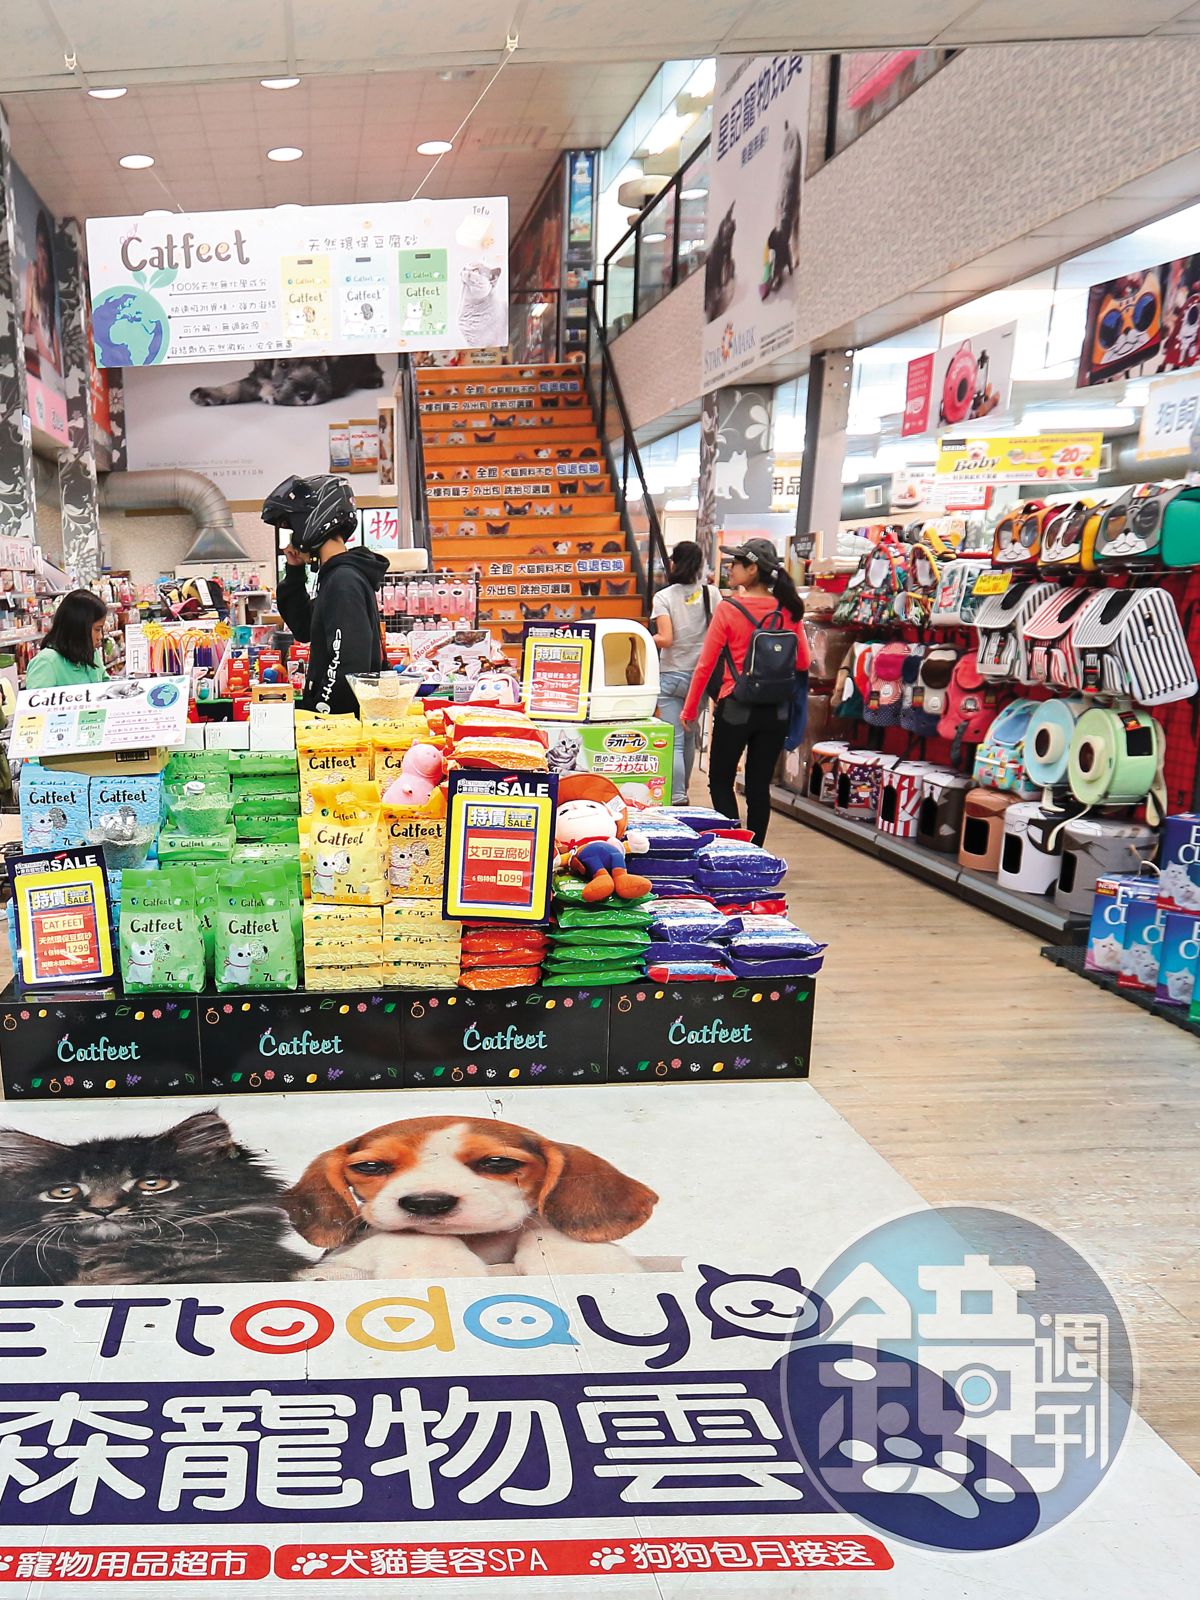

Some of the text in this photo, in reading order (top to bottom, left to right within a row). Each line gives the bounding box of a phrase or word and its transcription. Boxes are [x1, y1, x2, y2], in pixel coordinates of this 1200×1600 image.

[120, 229, 251, 272] Catfeet
[490, 564, 513, 575] 全館
[576, 559, 625, 573] 包退包換
[486, 586, 517, 597] 外出包
[555, 629, 590, 639] SALE
[28, 689, 92, 708] Catfeet
[607, 738, 646, 748] デオトイレ
[308, 755, 357, 770] Catfeet
[99, 789, 148, 804] Catfeet
[496, 781, 550, 797] SALE
[29, 790, 78, 805] Catfeet
[470, 807, 506, 828] 特價
[507, 819, 532, 828] SALE
[390, 822, 443, 838] Catfeet
[62, 837, 74, 847] 7L
[316, 829, 364, 847] Catfeet
[468, 845, 531, 860] 艾可豆腐砂
[50, 854, 98, 872] SALE
[422, 875, 434, 885] 7L
[497, 872, 522, 884] 1099
[345, 884, 357, 894] 7L
[68, 895, 89, 905] SALE
[43, 917, 83, 930] CAT FEET
[130, 917, 183, 933] Catfeet
[228, 918, 279, 935] Catfeet
[67, 943, 89, 954] 1299
[165, 971, 176, 981] 7L
[263, 972, 275, 982] 7L
[462, 1026, 549, 1053] Catfeet
[667, 1020, 753, 1047] Catfeet
[57, 1036, 141, 1062] Catfeet
[258, 1032, 343, 1058] Catfeet
[329, 1546, 548, 1576] 犬貓美容SPA
[631, 1540, 876, 1571] 狗狗包月接送
[16, 1549, 247, 1578] 寵物用品超市
